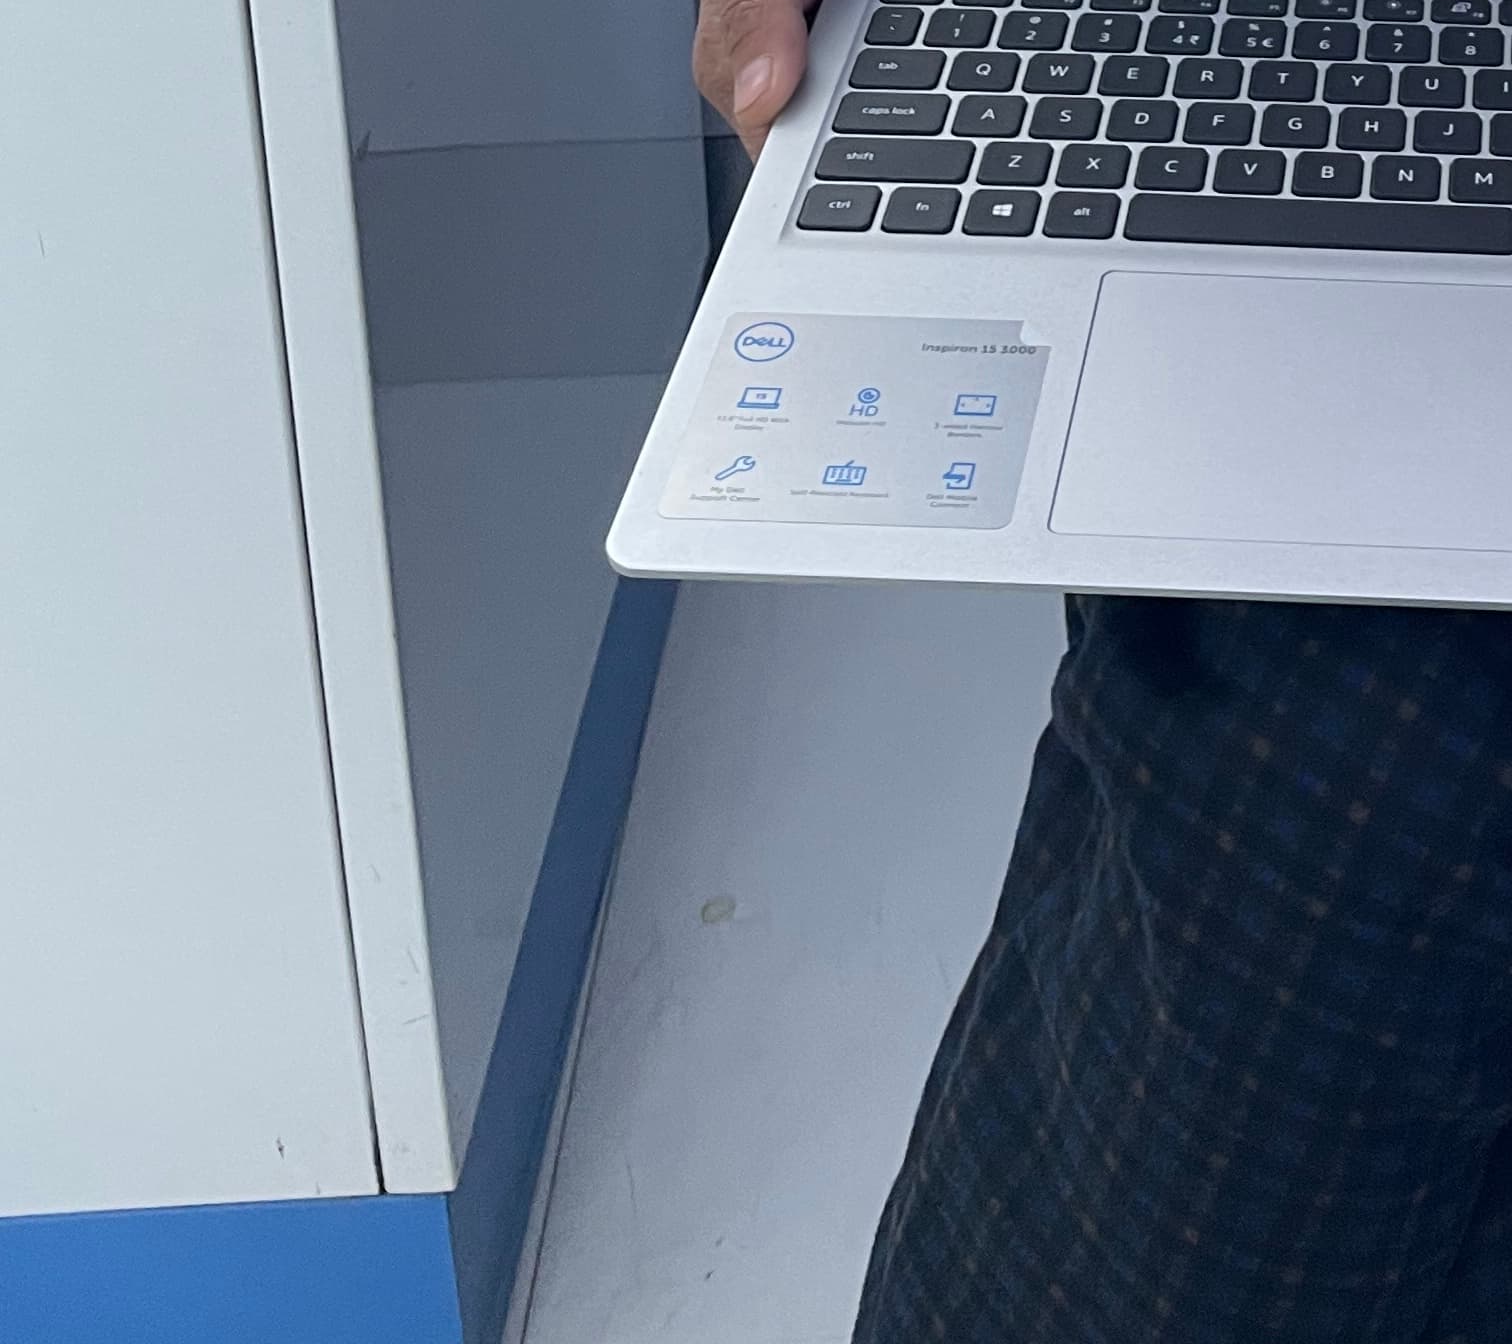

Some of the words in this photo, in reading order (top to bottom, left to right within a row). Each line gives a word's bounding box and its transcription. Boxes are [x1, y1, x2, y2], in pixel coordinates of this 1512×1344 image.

[1025, 30, 1037, 41] 2
[1098, 32, 1110, 43] 3
[1247, 36, 1257, 48] 5
[1319, 39, 1331, 50] 6
[1393, 42, 1403, 53] 7
[1464, 45, 1477, 56] 8
[878, 62, 899, 70] tab
[975, 63, 992, 76] Q
[1049, 65, 1069, 77] W
[1126, 67, 1140, 80] E
[1200, 70, 1214, 82] R
[1277, 72, 1289, 84] T
[1351, 75, 1365, 87] Y
[1424, 78, 1440, 91] U
[1503, 81, 1509, 93] I
[861, 106, 888, 116] caps
[889, 106, 915, 115] lock
[980, 108, 995, 120] A
[1059, 109, 1072, 123] S
[1134, 112, 1150, 125] D
[1212, 114, 1226, 127] F
[1287, 117, 1303, 130] G
[1364, 120, 1379, 133] H
[1442, 123, 1454, 136] J
[846, 151, 874, 161] shift
[1007, 154, 1023, 168] Z
[1085, 157, 1102, 170] X
[1164, 159, 1179, 173] C
[1243, 162, 1258, 176] V
[1320, 165, 1335, 179] B
[1398, 169, 1414, 182] N
[1474, 171, 1493, 185] M
[828, 200, 851, 209] ctrl
[915, 201, 930, 211] fn
[1073, 207, 1091, 216] alt
[922, 342, 978, 355] Inspiron
[999, 345, 1037, 355] 3000
[849, 404, 878, 417] HD
